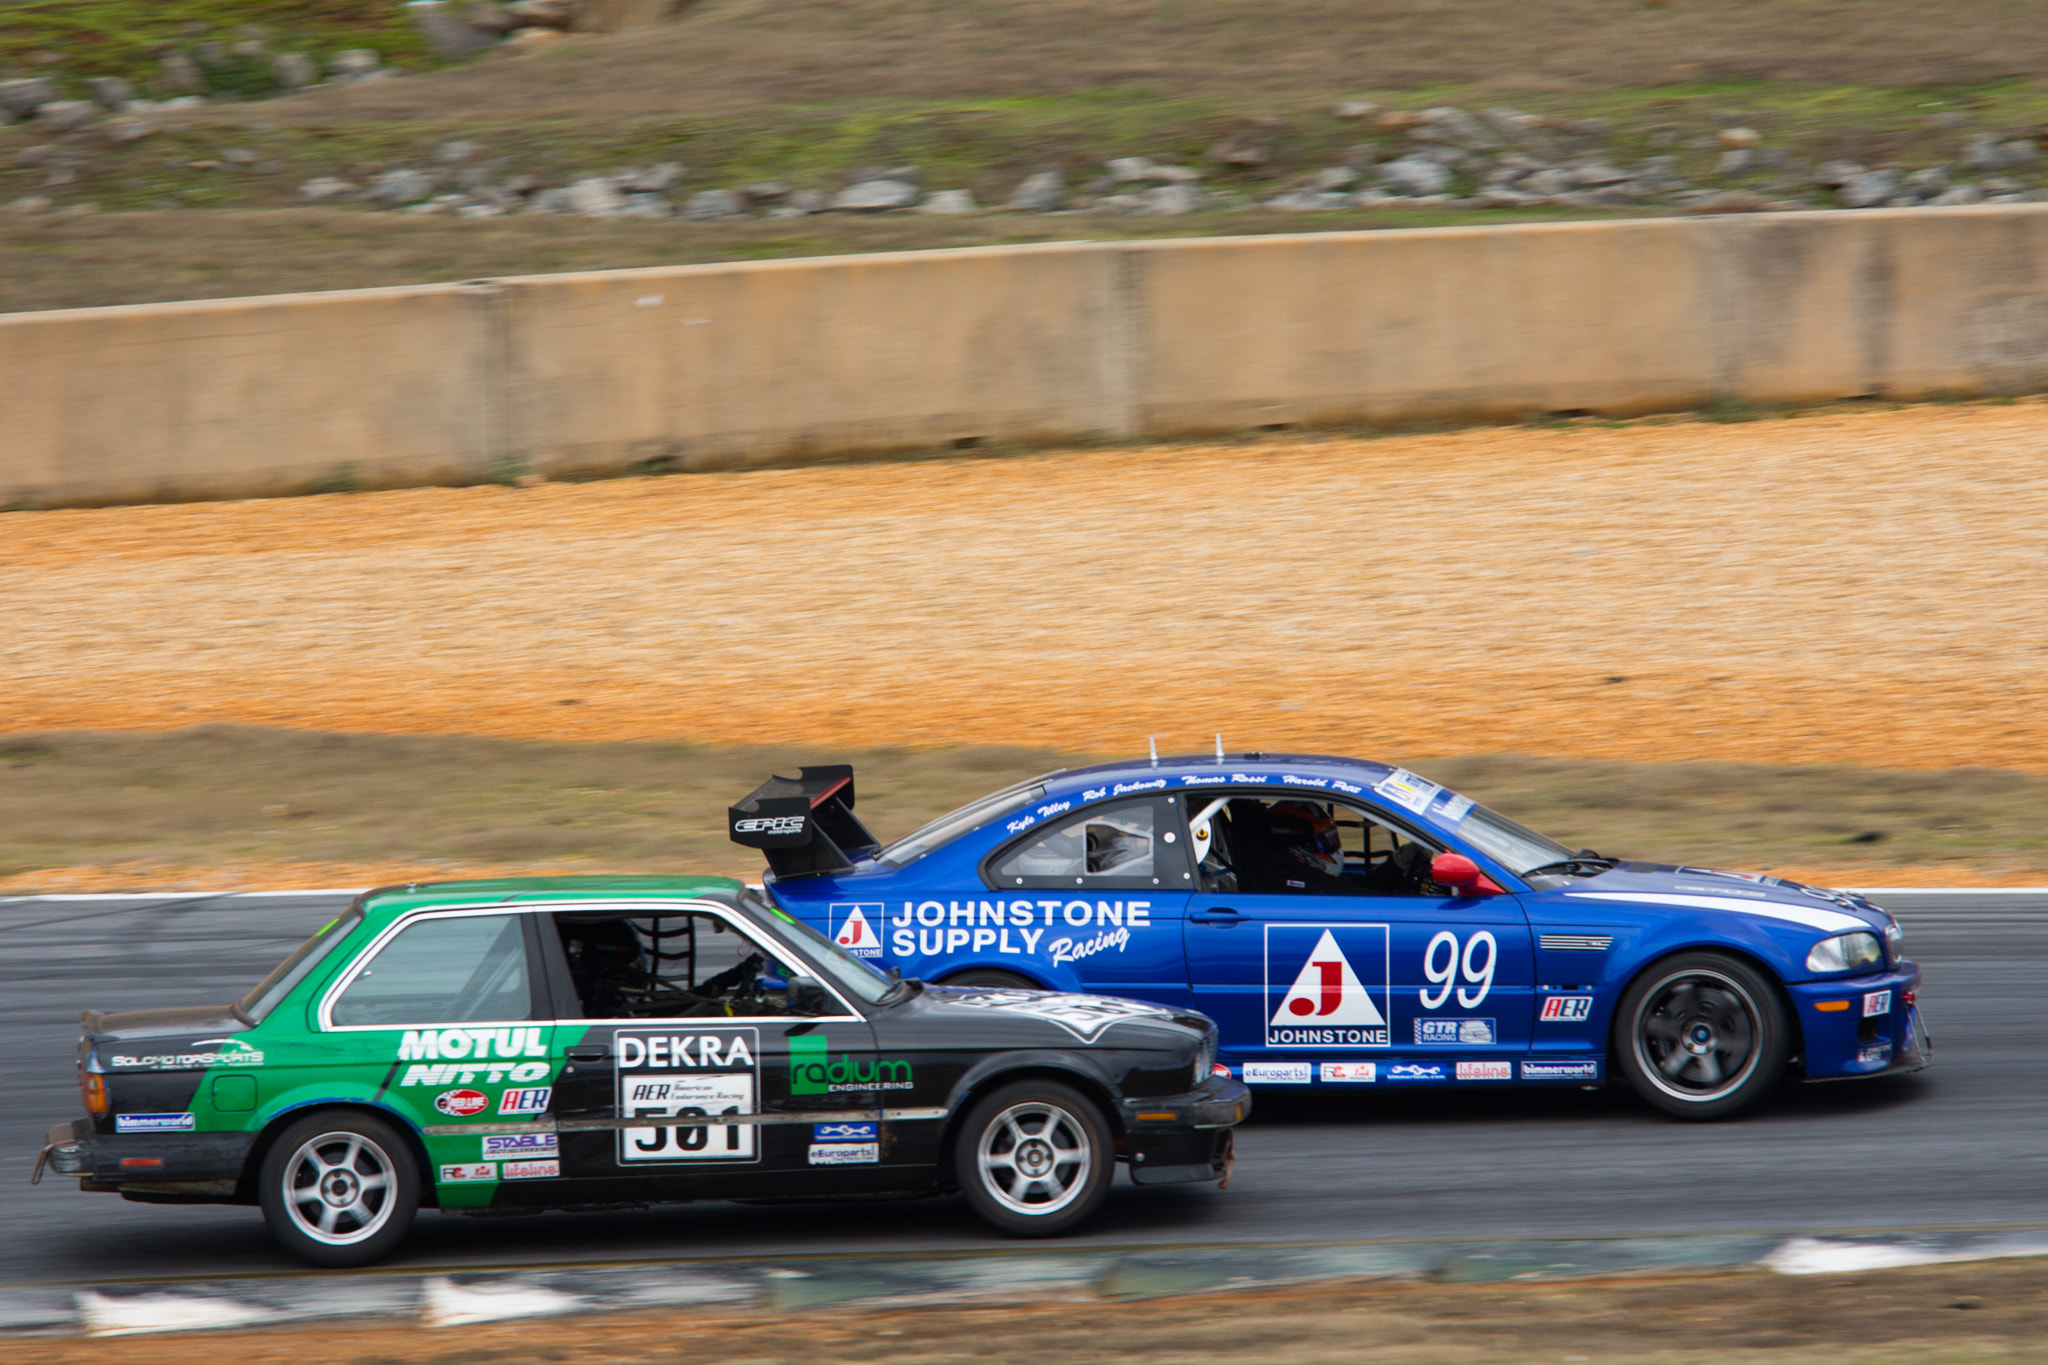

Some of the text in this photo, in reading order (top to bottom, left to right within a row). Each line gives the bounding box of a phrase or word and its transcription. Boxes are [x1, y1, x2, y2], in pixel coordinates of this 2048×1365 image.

[1181, 773, 1268, 786] Thomas Rossi
[1282, 775, 1328, 787] Harold
[1082, 787, 1106, 801] Rob
[735, 816, 805, 832] EPIC
[1007, 816, 1035, 833] Kyle
[892, 901, 1150, 927] JOHNSTONE
[892, 927, 1130, 968] SUPPLY Racing
[1419, 930, 1497, 1009] 99
[1545, 998, 1590, 1017] AER
[1422, 1021, 1458, 1034] GTR
[397, 1028, 547, 1060] MOTUL
[1269, 1030, 1387, 1044] JOHNSTONE
[1422, 1033, 1457, 1042] RACING
[618, 1036, 754, 1068] DEKRA
[399, 1062, 551, 1086] NITTO
[792, 1054, 912, 1084] radium
[1457, 1063, 1510, 1078] lifeline
[1524, 1063, 1595, 1075] bimmerworld
[632, 1084, 670, 1100] AER
[828, 1081, 914, 1092] ENGINEERING
[501, 1089, 550, 1111] AER
[119, 1113, 193, 1127] bimmerworld
[634, 1105, 740, 1152] 501
[487, 1135, 557, 1149] STABLE
